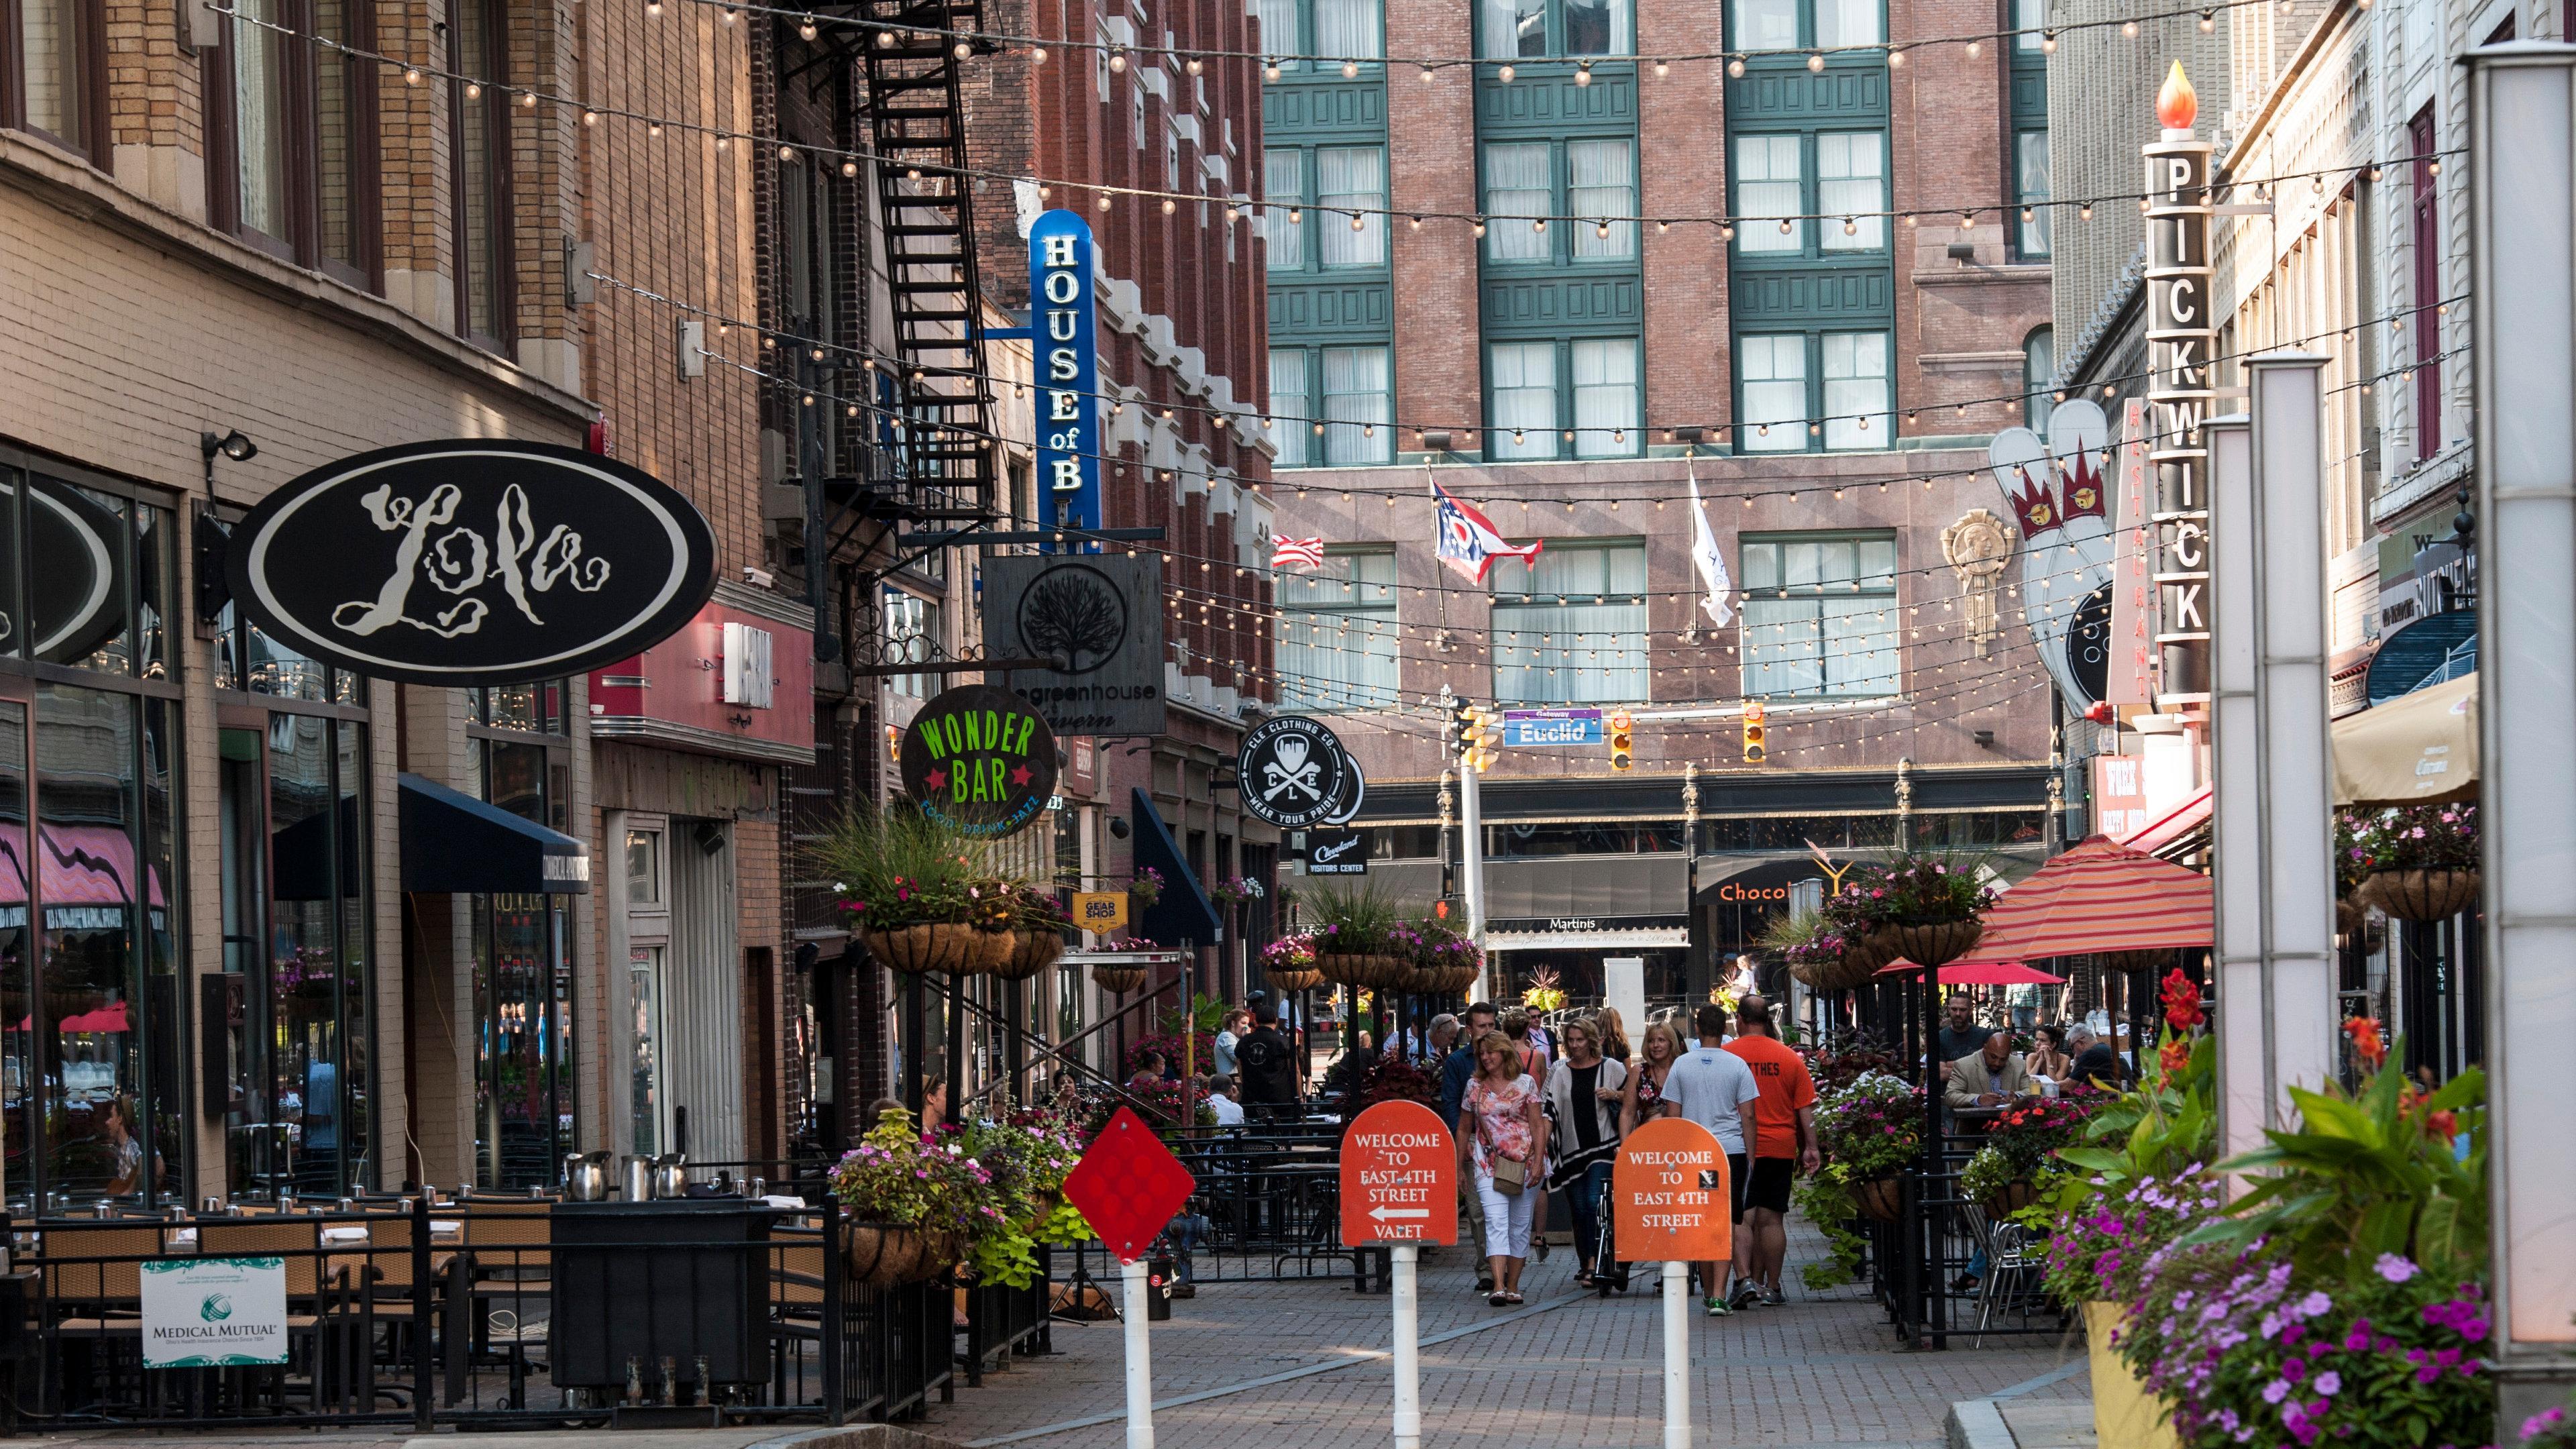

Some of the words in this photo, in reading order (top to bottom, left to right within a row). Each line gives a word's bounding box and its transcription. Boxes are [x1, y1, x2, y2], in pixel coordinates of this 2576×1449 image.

[1044, 235, 1079, 421] HOUSE
[2169, 158, 2202, 628] PICKWICK
[1050, 427, 1081, 450] of
[2130, 405, 2146, 696] RESTAURANT
[331, 483, 611, 639] Lola
[1042, 710, 1116, 729] avern
[918, 710, 1035, 760] WONDER
[1248, 733, 1267, 750] CLE
[1269, 720, 1319, 734] CLOTHING
[1320, 733, 1334, 750] CO.
[1519, 722, 1586, 743] Euclid
[952, 758, 1007, 804] BAR
[963, 820, 1006, 835] DRINK
[1010, 794, 1040, 824] JAZZ
[1249, 796, 1273, 819] WEAR
[1279, 814, 1306, 824] YOUR
[1310, 794, 1337, 819] PRIDE
[1314, 835, 1359, 863] Cleveland
[1310, 864, 1338, 872] VISITORS
[1340, 864, 1364, 872] CENTER
[1085, 902, 1116, 910] GEAR
[1085, 910, 1116, 918] SHOP
[1550, 918, 1596, 930] Martinis
[1354, 1134, 1440, 1148] WELCOME
[1385, 1152, 1410, 1166] TO
[1629, 1150, 1713, 1165] WELCOME
[1360, 1171, 1399, 1185] EAST
[1403, 1170, 1436, 1184] 4TH
[1659, 1171, 1683, 1185] TO
[1368, 1188, 1429, 1202] STREET
[1633, 1192, 1674, 1205] EAST
[1677, 1191, 1709, 1205] 4TH
[1642, 1214, 1703, 1228] STREET
[1374, 1224, 1424, 1238] VALET
[153, 1326, 215, 1339] MEDICAL
